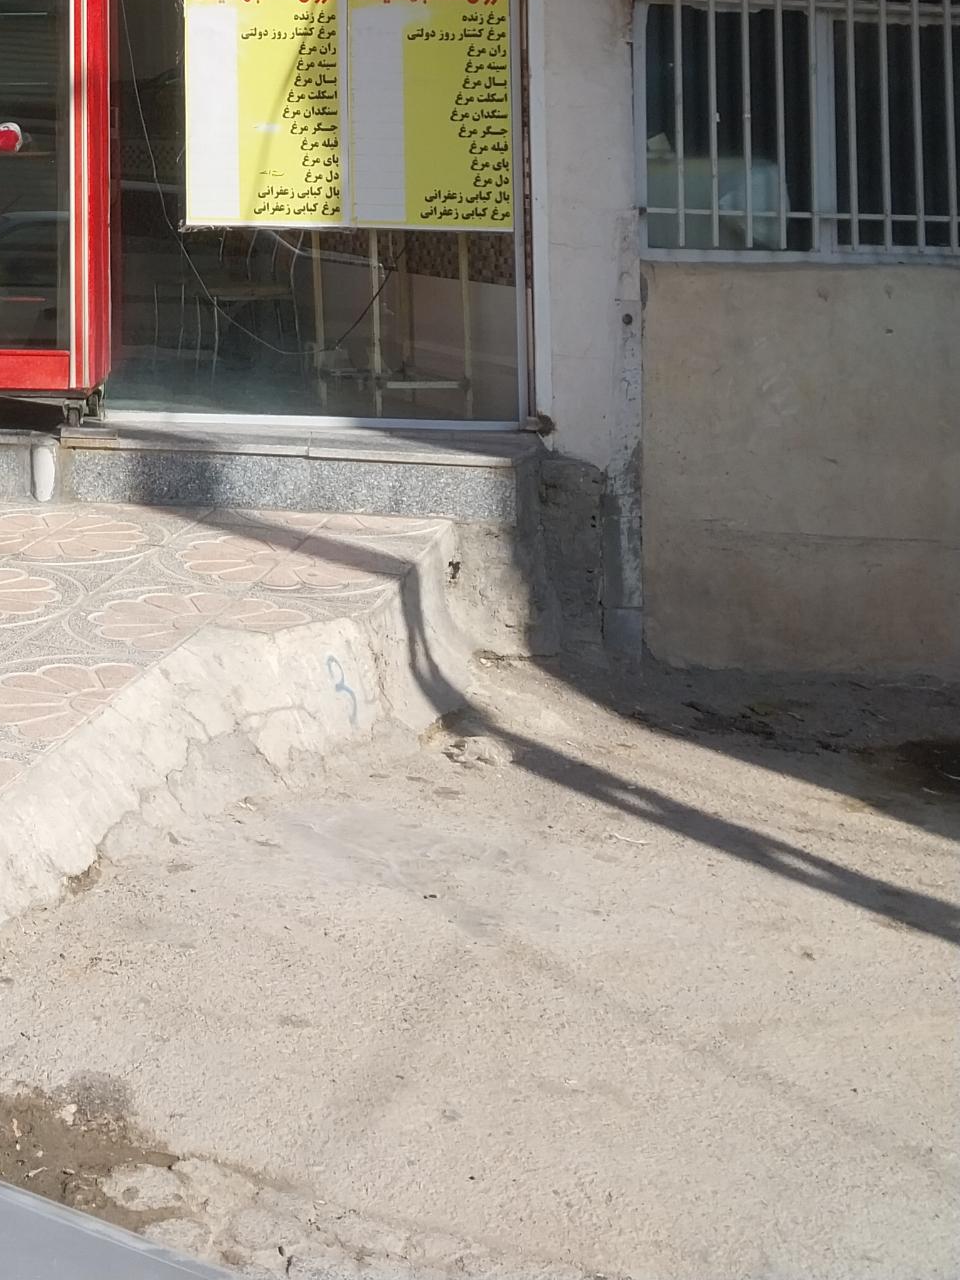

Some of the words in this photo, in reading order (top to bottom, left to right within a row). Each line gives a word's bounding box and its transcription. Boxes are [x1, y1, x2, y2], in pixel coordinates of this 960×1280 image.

[294, 12, 315, 23] زنده
[317, 11, 336, 24] مرغ
[462, 13, 484, 24] زنده
[487, 11, 506, 24] مرغ
[241, 27, 268, 40] دولتی
[271, 30, 286, 40] روز
[290, 27, 314, 39] کشتار
[317, 27, 336, 39] مرغ
[407, 28, 435, 40] دولتی
[439, 31, 455, 40] روز
[459, 28, 484, 40] کشتار
[487, 28, 506, 40] مرغ
[298, 43, 316, 55] مرغ
[319, 44, 336, 55] ران
[467, 44, 486, 56] مرغ
[489, 45, 506, 56] ران
[297, 59, 315, 71] مرغ
[318, 60, 336, 70] سینه
[465, 61, 484, 73] مرغ
[487, 62, 506, 72] سینه
[294, 74, 312, 86] مرغ
[315, 75, 337, 86] بال
[463, 76, 482, 89] مرغ
[484, 77, 507, 89] بال
[287, 90, 305, 102] مرغ
[455, 91, 474, 105] مرغ
[282, 106, 300, 118] مرغ
[450, 108, 470, 121] مرغ
[290, 122, 308, 134] مرغ
[458, 124, 478, 137] مرغ
[300, 137, 319, 149] مرغ
[322, 137, 339, 150] فیله
[469, 141, 488, 153] مرغ
[492, 141, 509, 153] فیله
[302, 153, 320, 166] مرغ
[323, 154, 339, 167] پای
[471, 157, 490, 170] مرغ
[493, 159, 509, 171] پای
[305, 171, 323, 182] مرغ
[326, 170, 339, 182] دل
[474, 174, 492, 186] مرغ
[496, 175, 509, 186] دل
[258, 186, 294, 199] زعفرانی
[298, 186, 322, 199] کبابی
[326, 186, 340, 199] بال
[425, 189, 463, 203] زعفرانی
[466, 191, 492, 204] کبابی
[496, 191, 510, 204] بال
[254, 203, 290, 215] زعفرانی
[294, 203, 318, 215] کبابی
[322, 203, 340, 215] مرغ
[420, 206, 458, 220] زعفرانی
[462, 207, 488, 220] کبابی
[491, 207, 510, 220] مرغ
